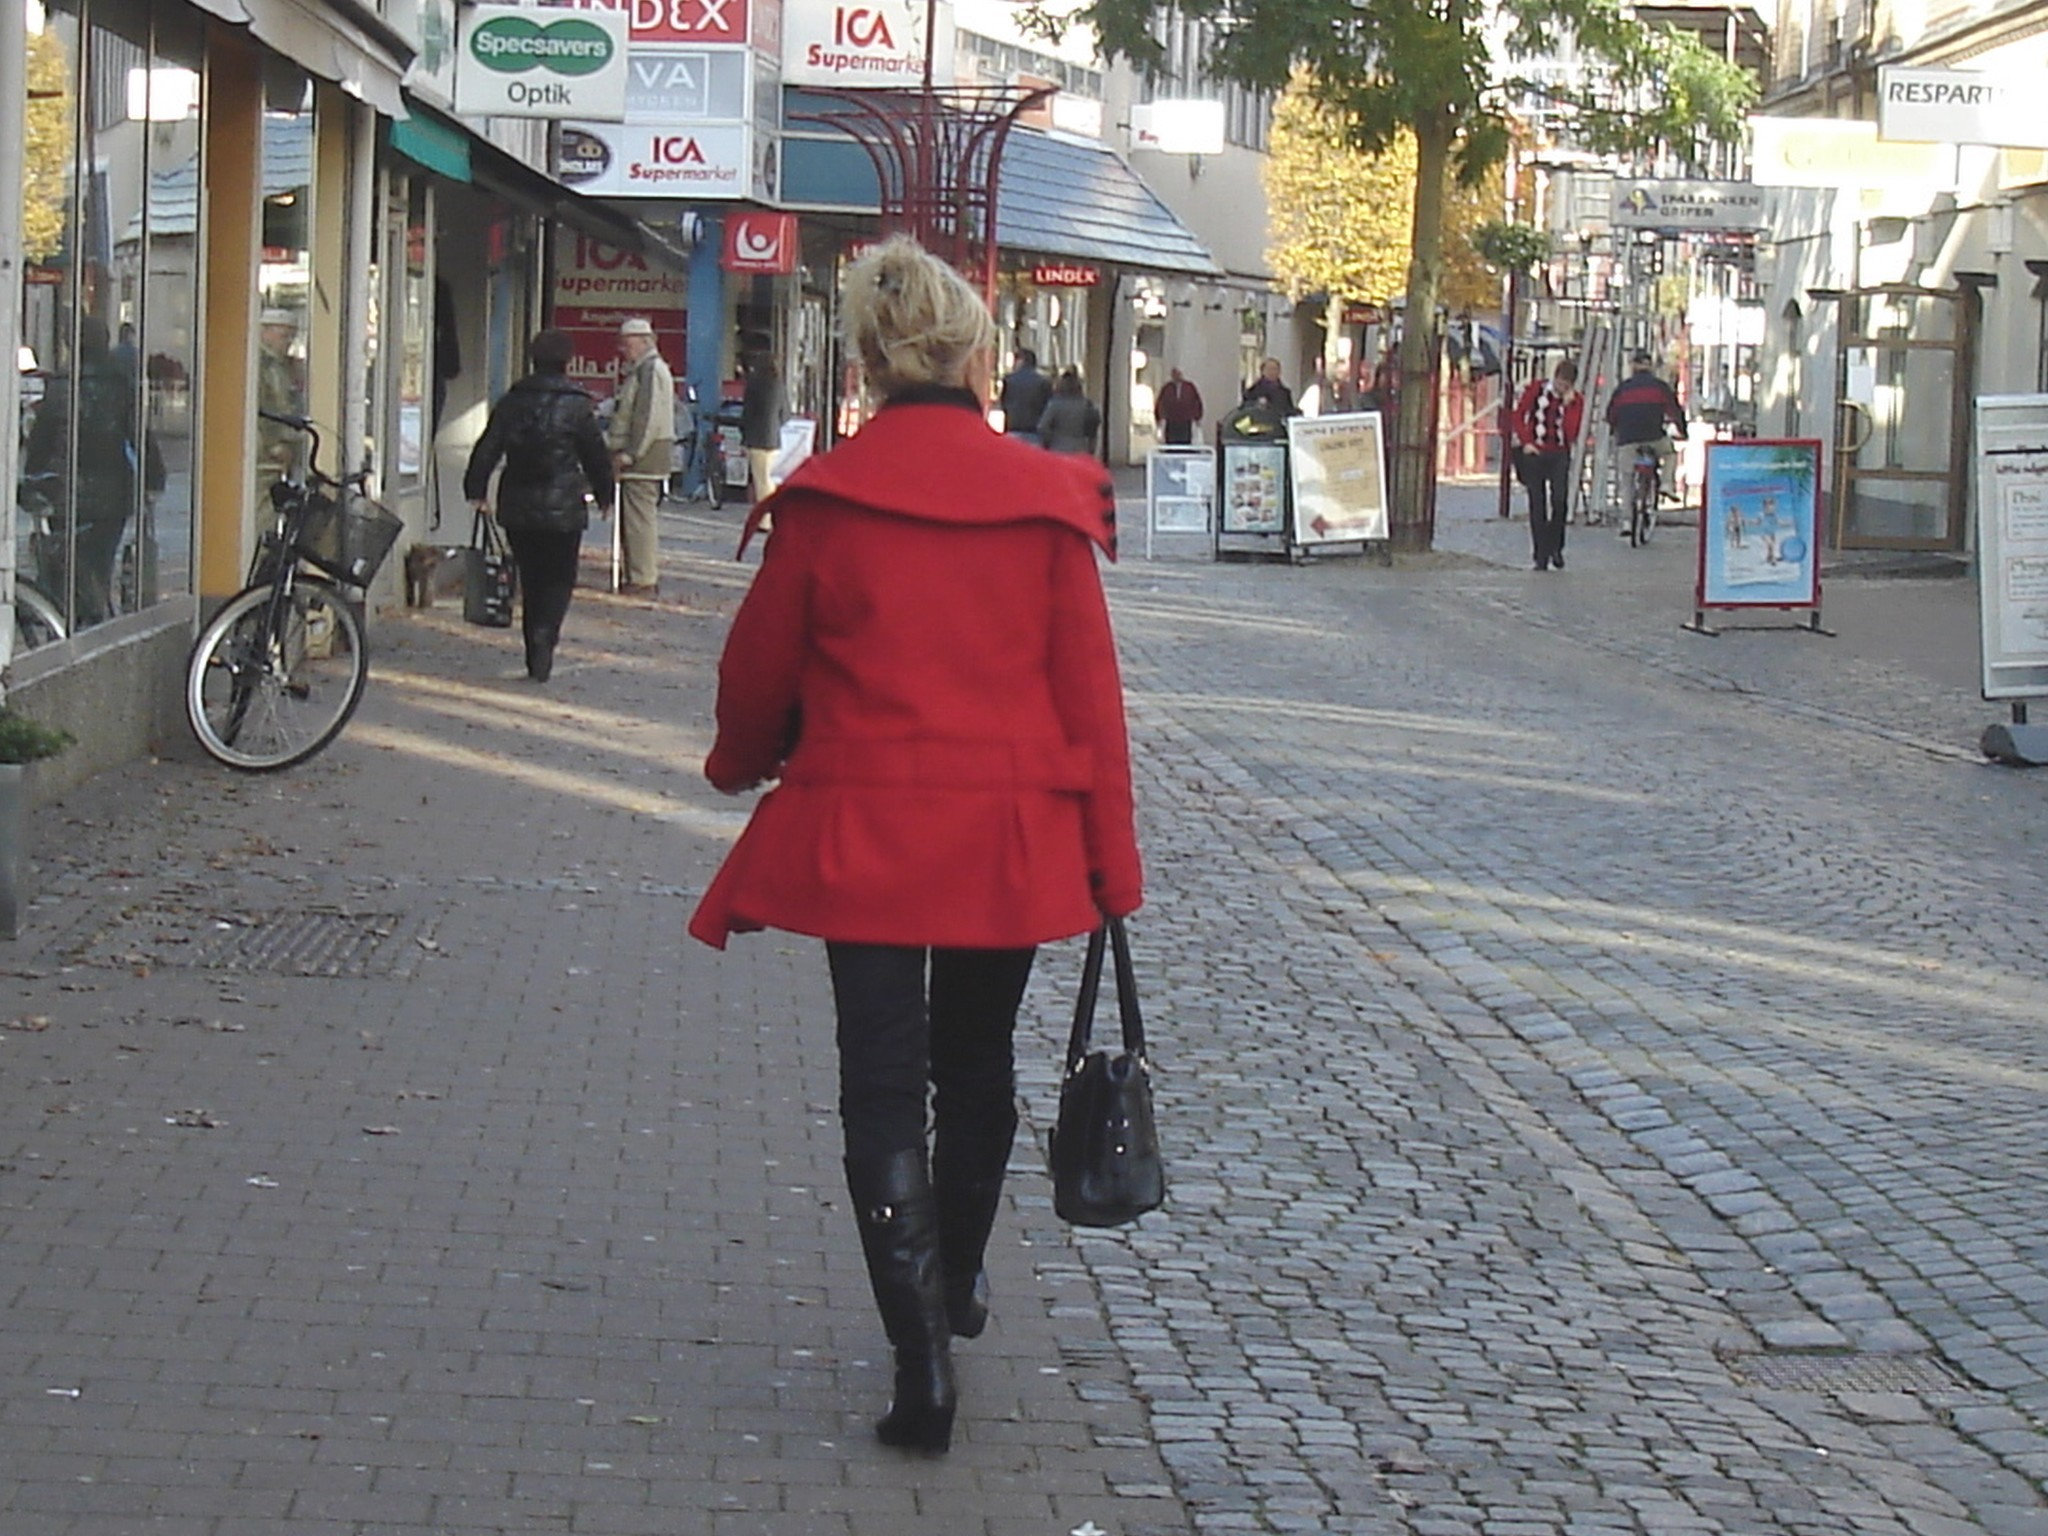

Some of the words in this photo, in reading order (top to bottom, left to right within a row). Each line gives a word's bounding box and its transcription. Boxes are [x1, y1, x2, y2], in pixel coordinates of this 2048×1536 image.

[834, 6, 895, 50] ICA
[476, 31, 607, 57] Specsavers
[806, 44, 927, 75] Supermarke
[507, 81, 572, 106] Optik
[652, 136, 705, 164] ICA
[629, 163, 737, 182] Supermarket
